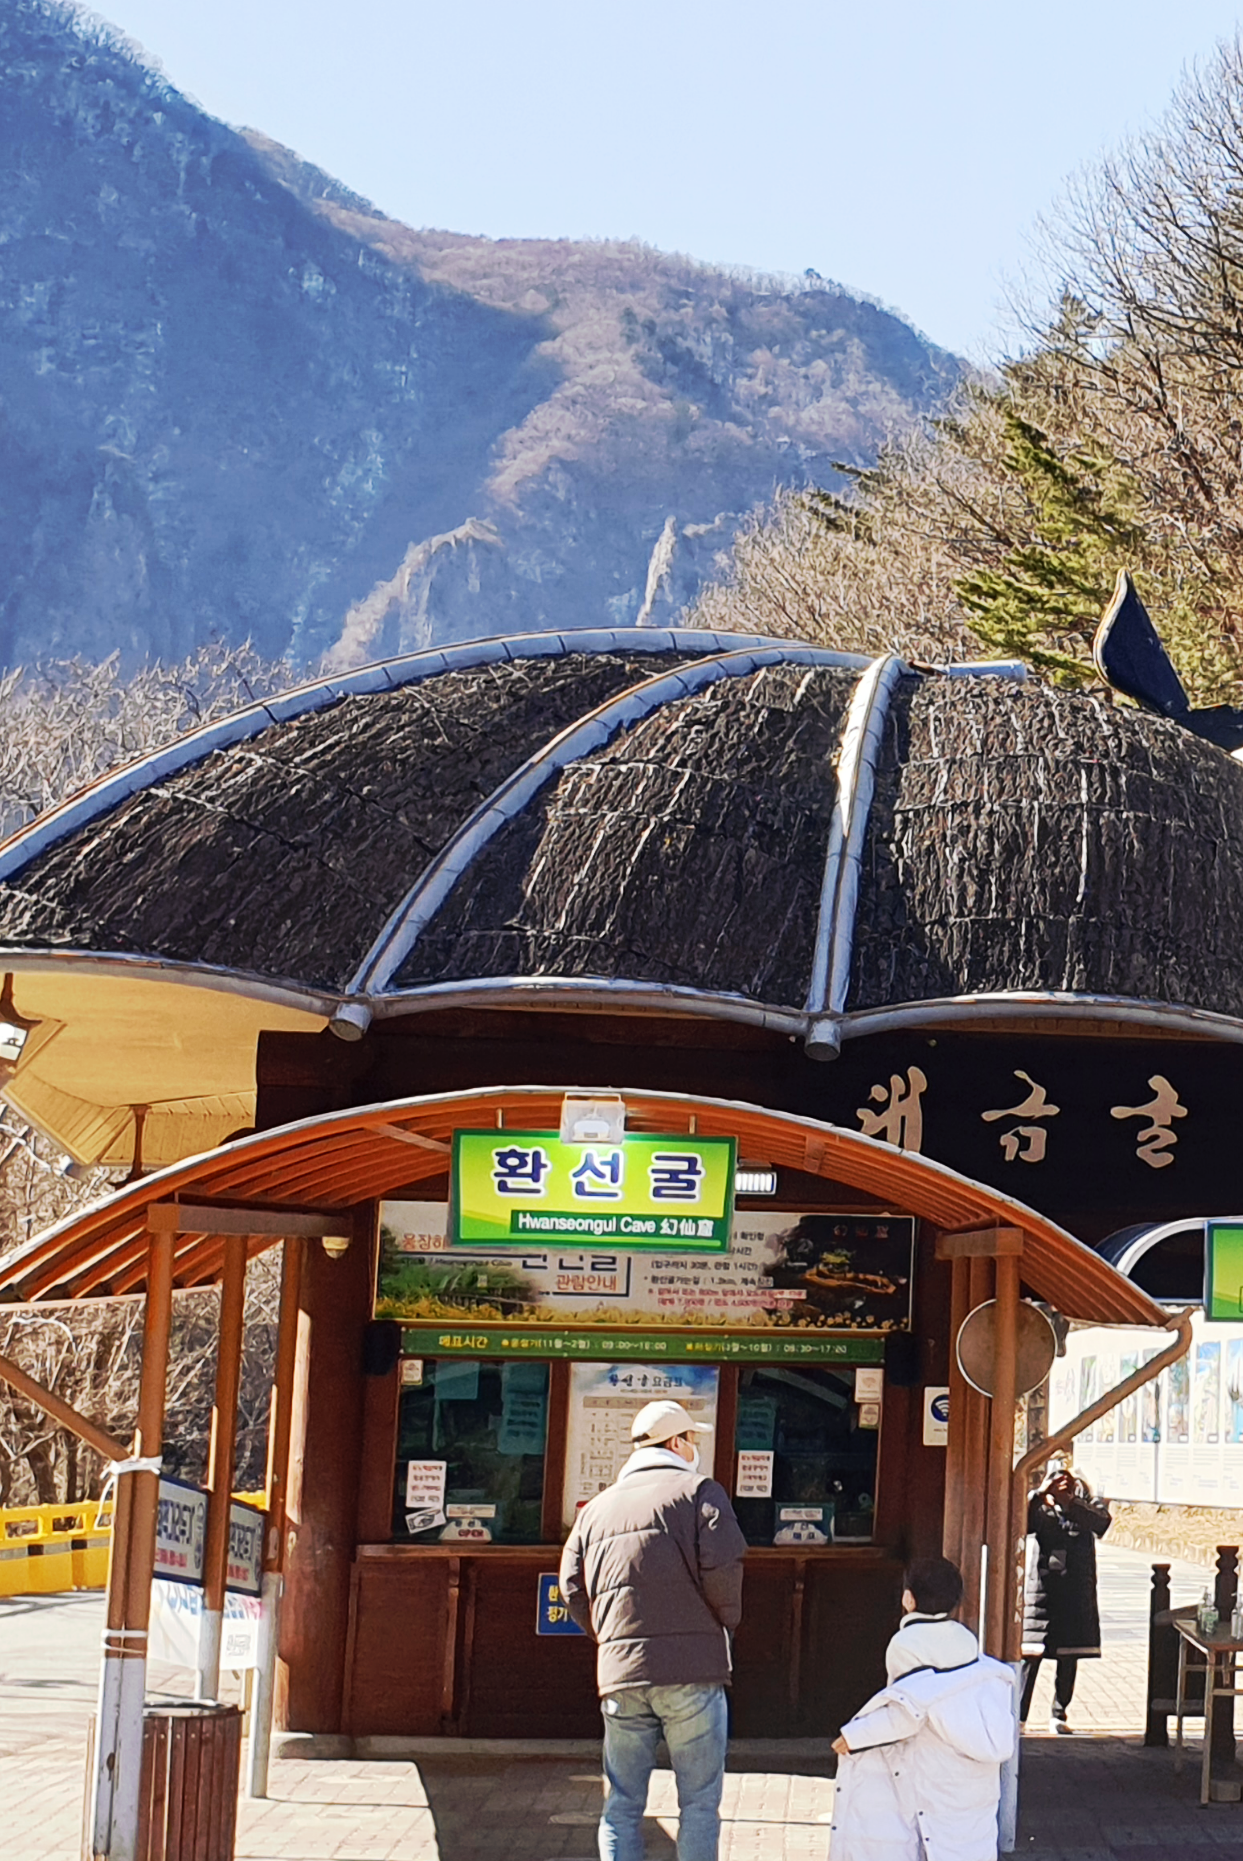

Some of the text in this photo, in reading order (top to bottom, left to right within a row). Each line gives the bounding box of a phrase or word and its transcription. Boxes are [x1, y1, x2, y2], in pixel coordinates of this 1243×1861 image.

[492, 1147, 704, 1202] 환선굴
[517, 1212, 617, 1235] Hwanseongul
[619, 1215, 656, 1234] Cave
[555, 1274, 618, 1292] 관람안내
